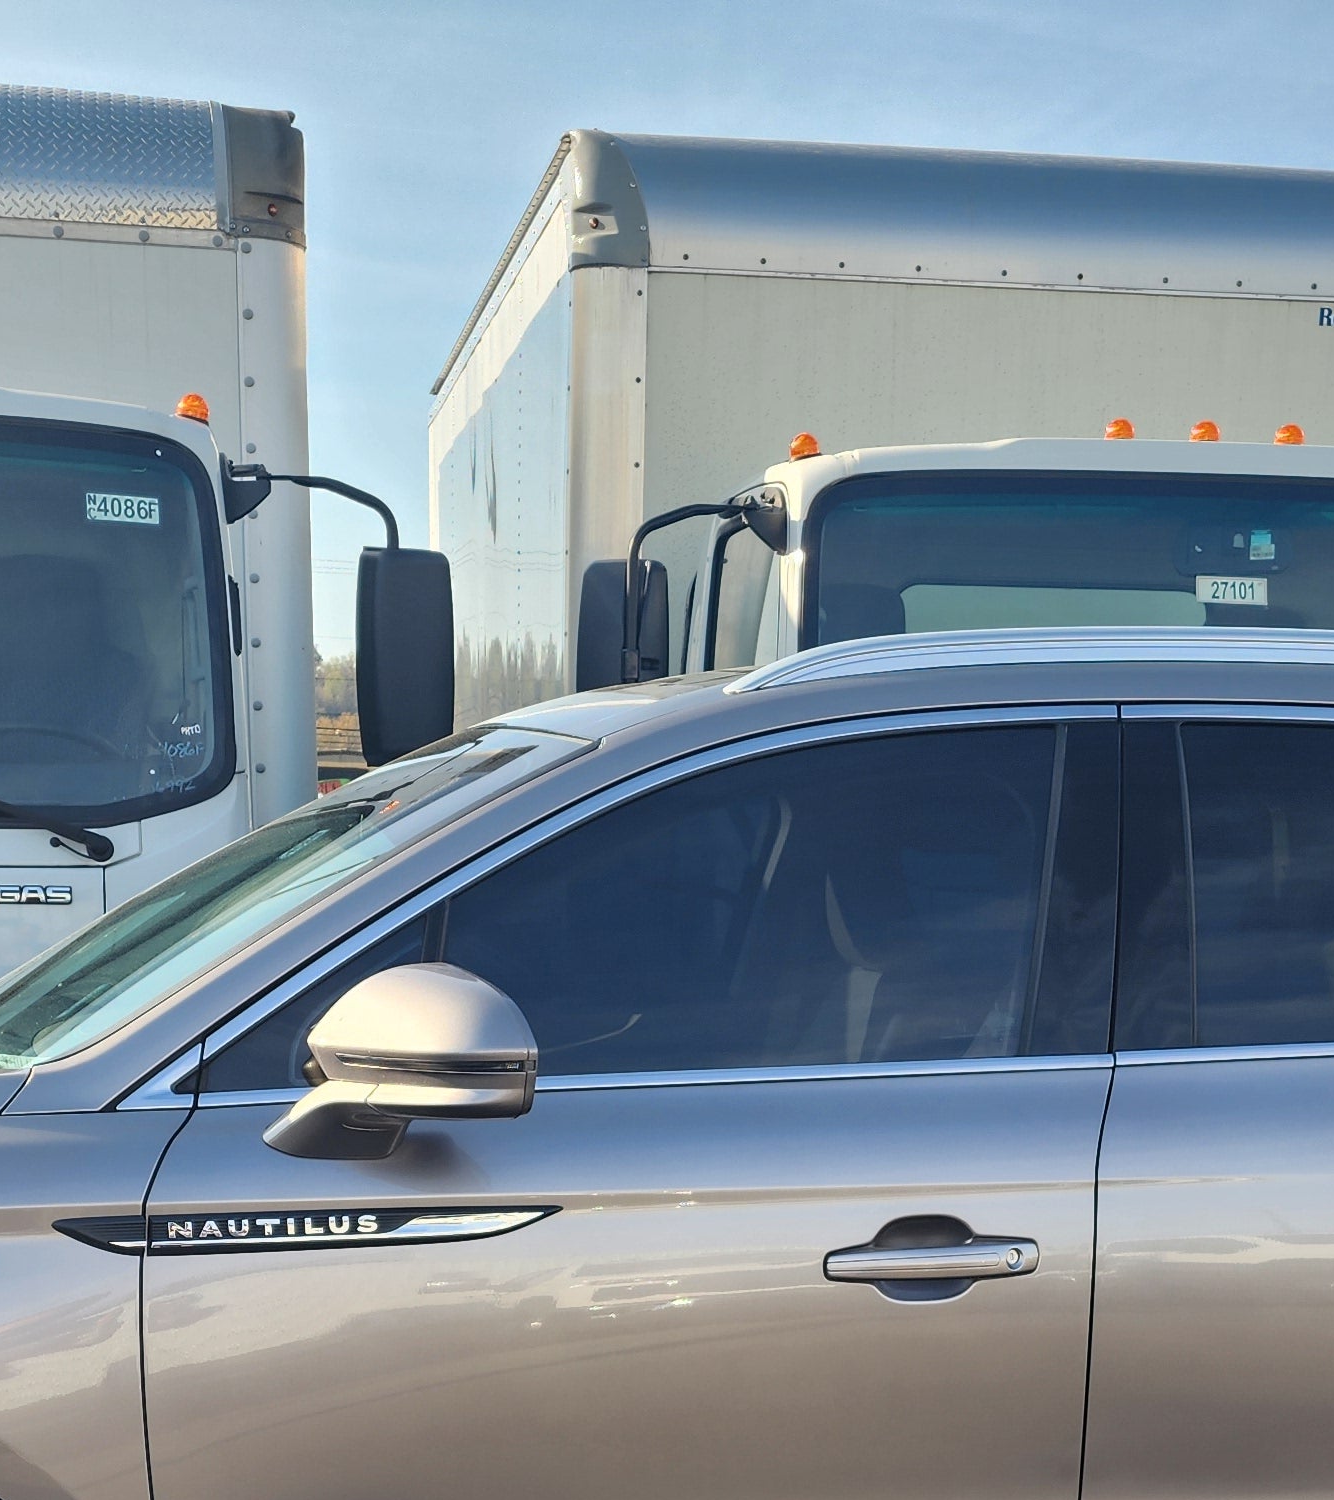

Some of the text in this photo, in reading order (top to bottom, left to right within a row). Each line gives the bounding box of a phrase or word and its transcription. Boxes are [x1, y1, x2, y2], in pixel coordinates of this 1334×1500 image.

[97, 496, 158, 520] 4086F
[1210, 580, 1255, 601] 27101
[167, 1214, 379, 1239] NAUTILUS
